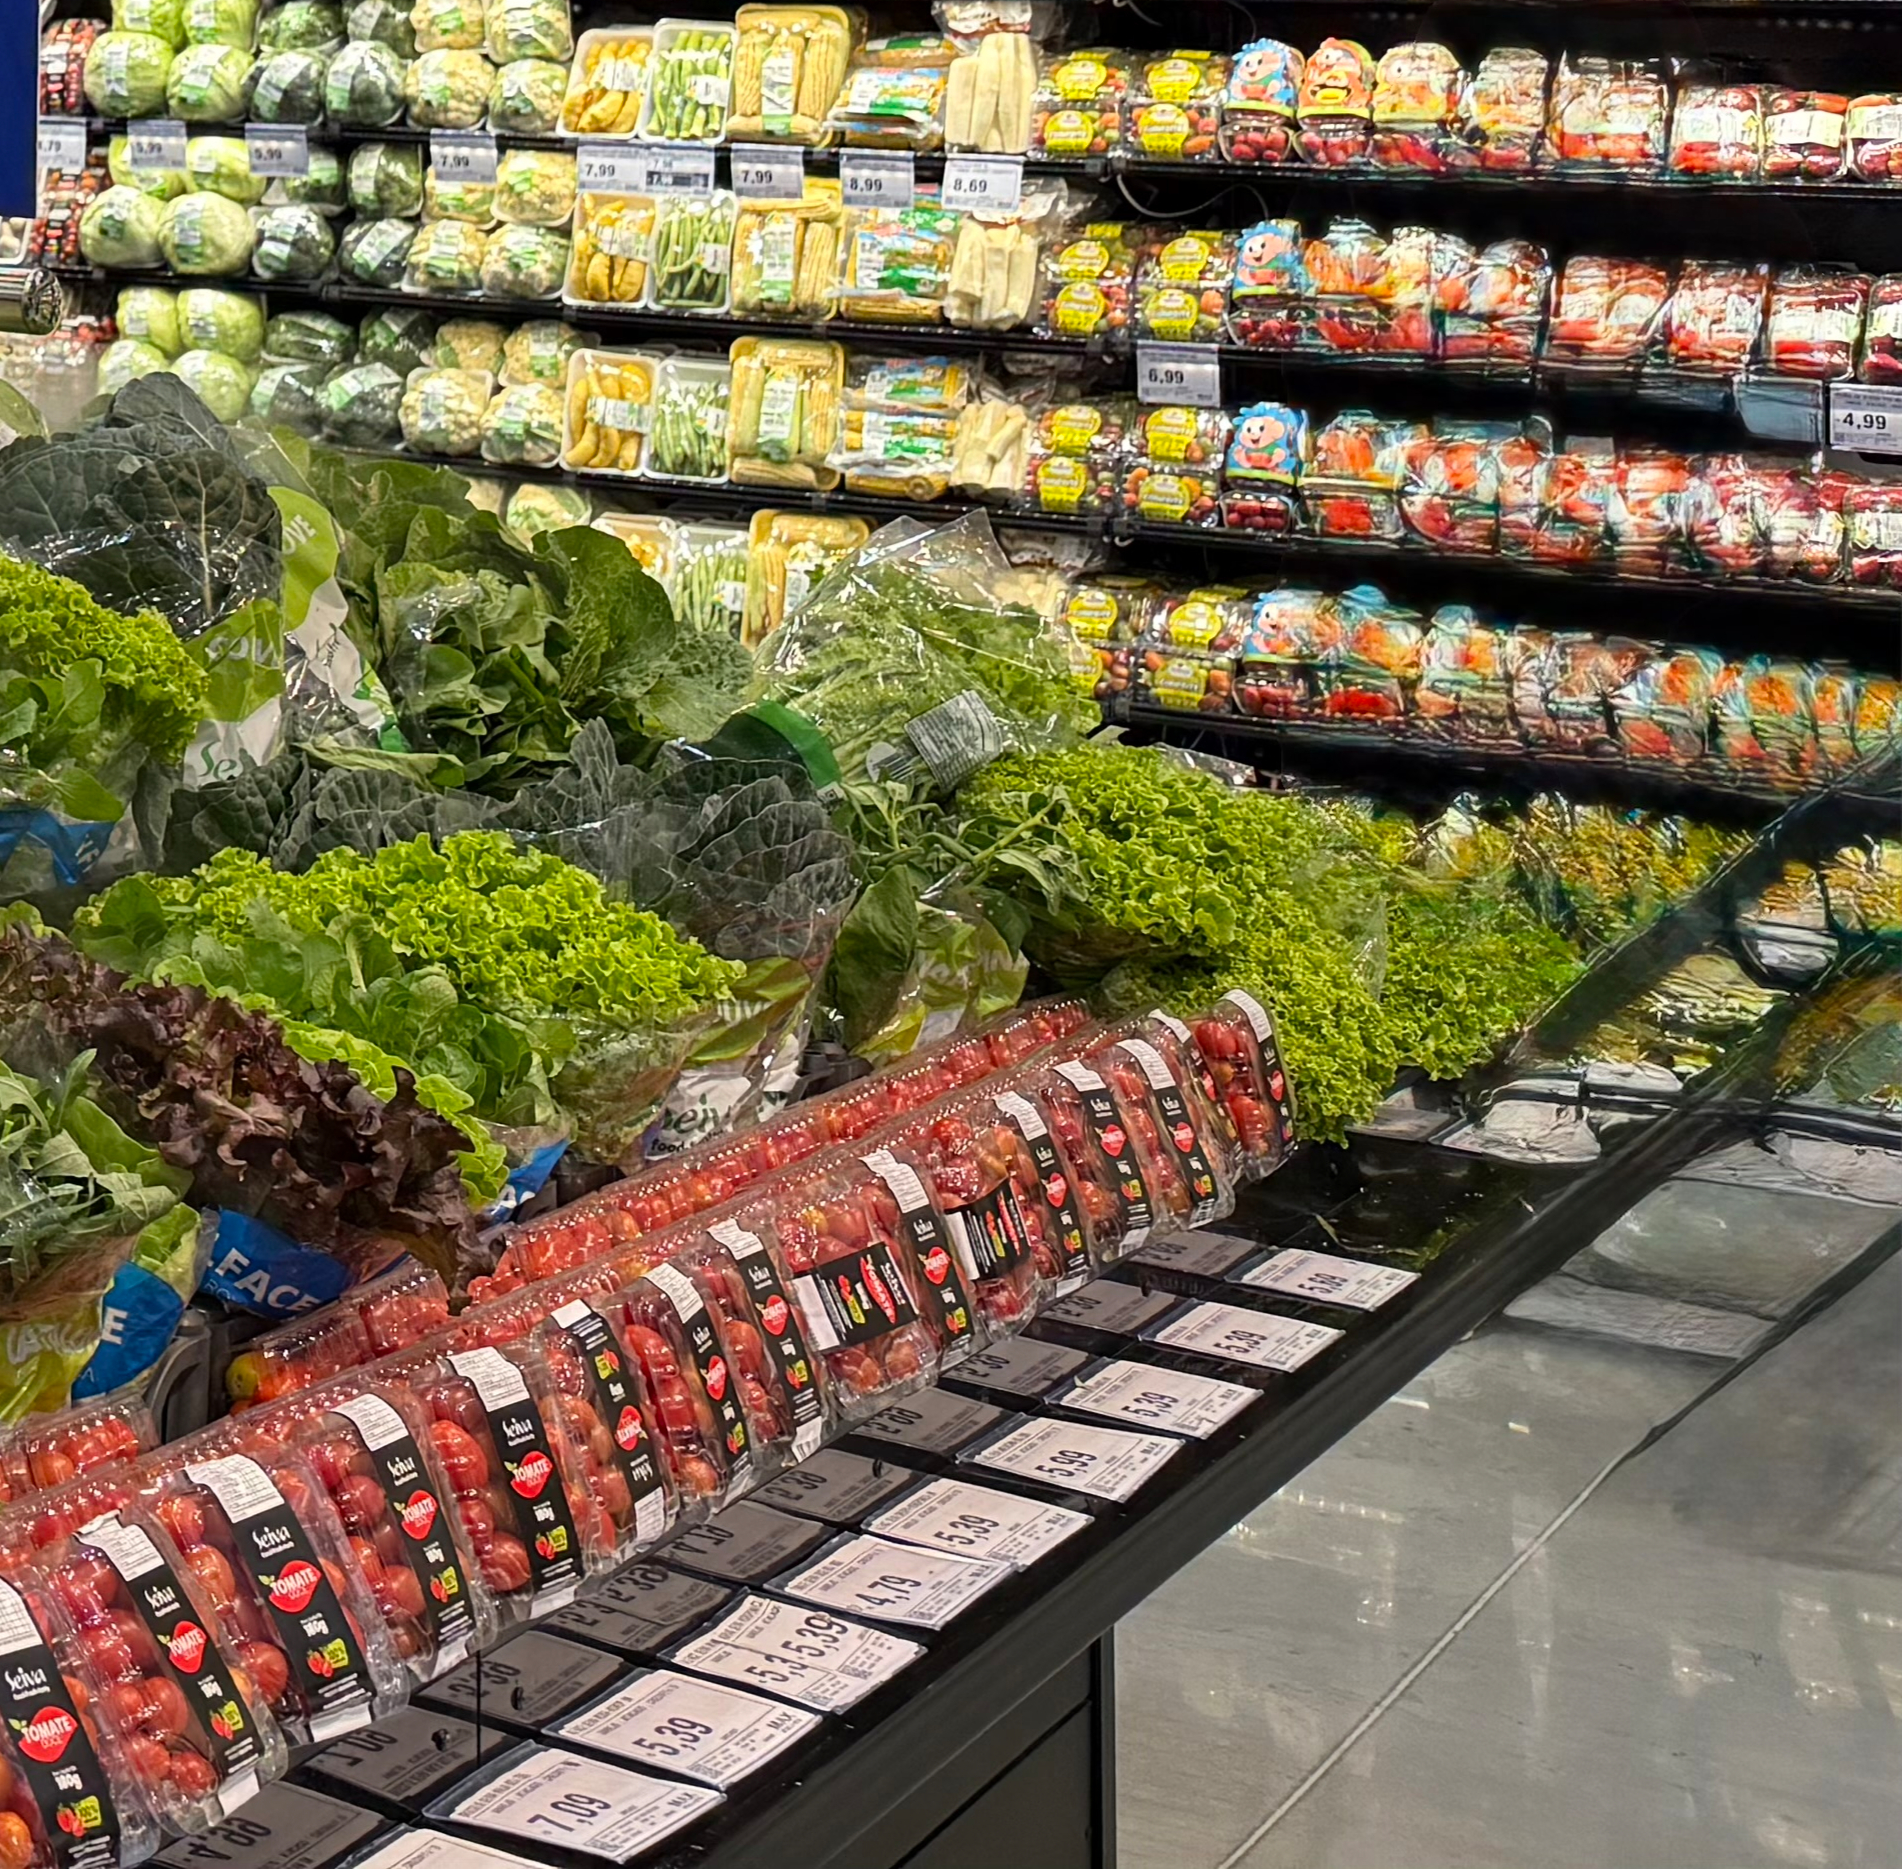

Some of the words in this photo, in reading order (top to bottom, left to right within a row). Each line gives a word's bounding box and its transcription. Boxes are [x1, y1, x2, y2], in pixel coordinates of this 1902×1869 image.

[584, 163, 616, 178] 7,99
[741, 169, 773, 184] 7,99
[849, 177, 883, 193] 8,99
[953, 178, 988, 194] 8,69
[1148, 368, 1184, 384] 6,99
[1842, 413, 1886, 430] 4,99
[1036, 1447, 1098, 1479] 5,99
[934, 1514, 1000, 1547] 5,39
[271, 1567, 318, 1597] TOMATE
[855, 1574, 922, 1608] 4,79
[23, 1716, 72, 1744] TOMATE
[632, 1716, 714, 1756] 5,39
[527, 1793, 612, 1833] 7,09
